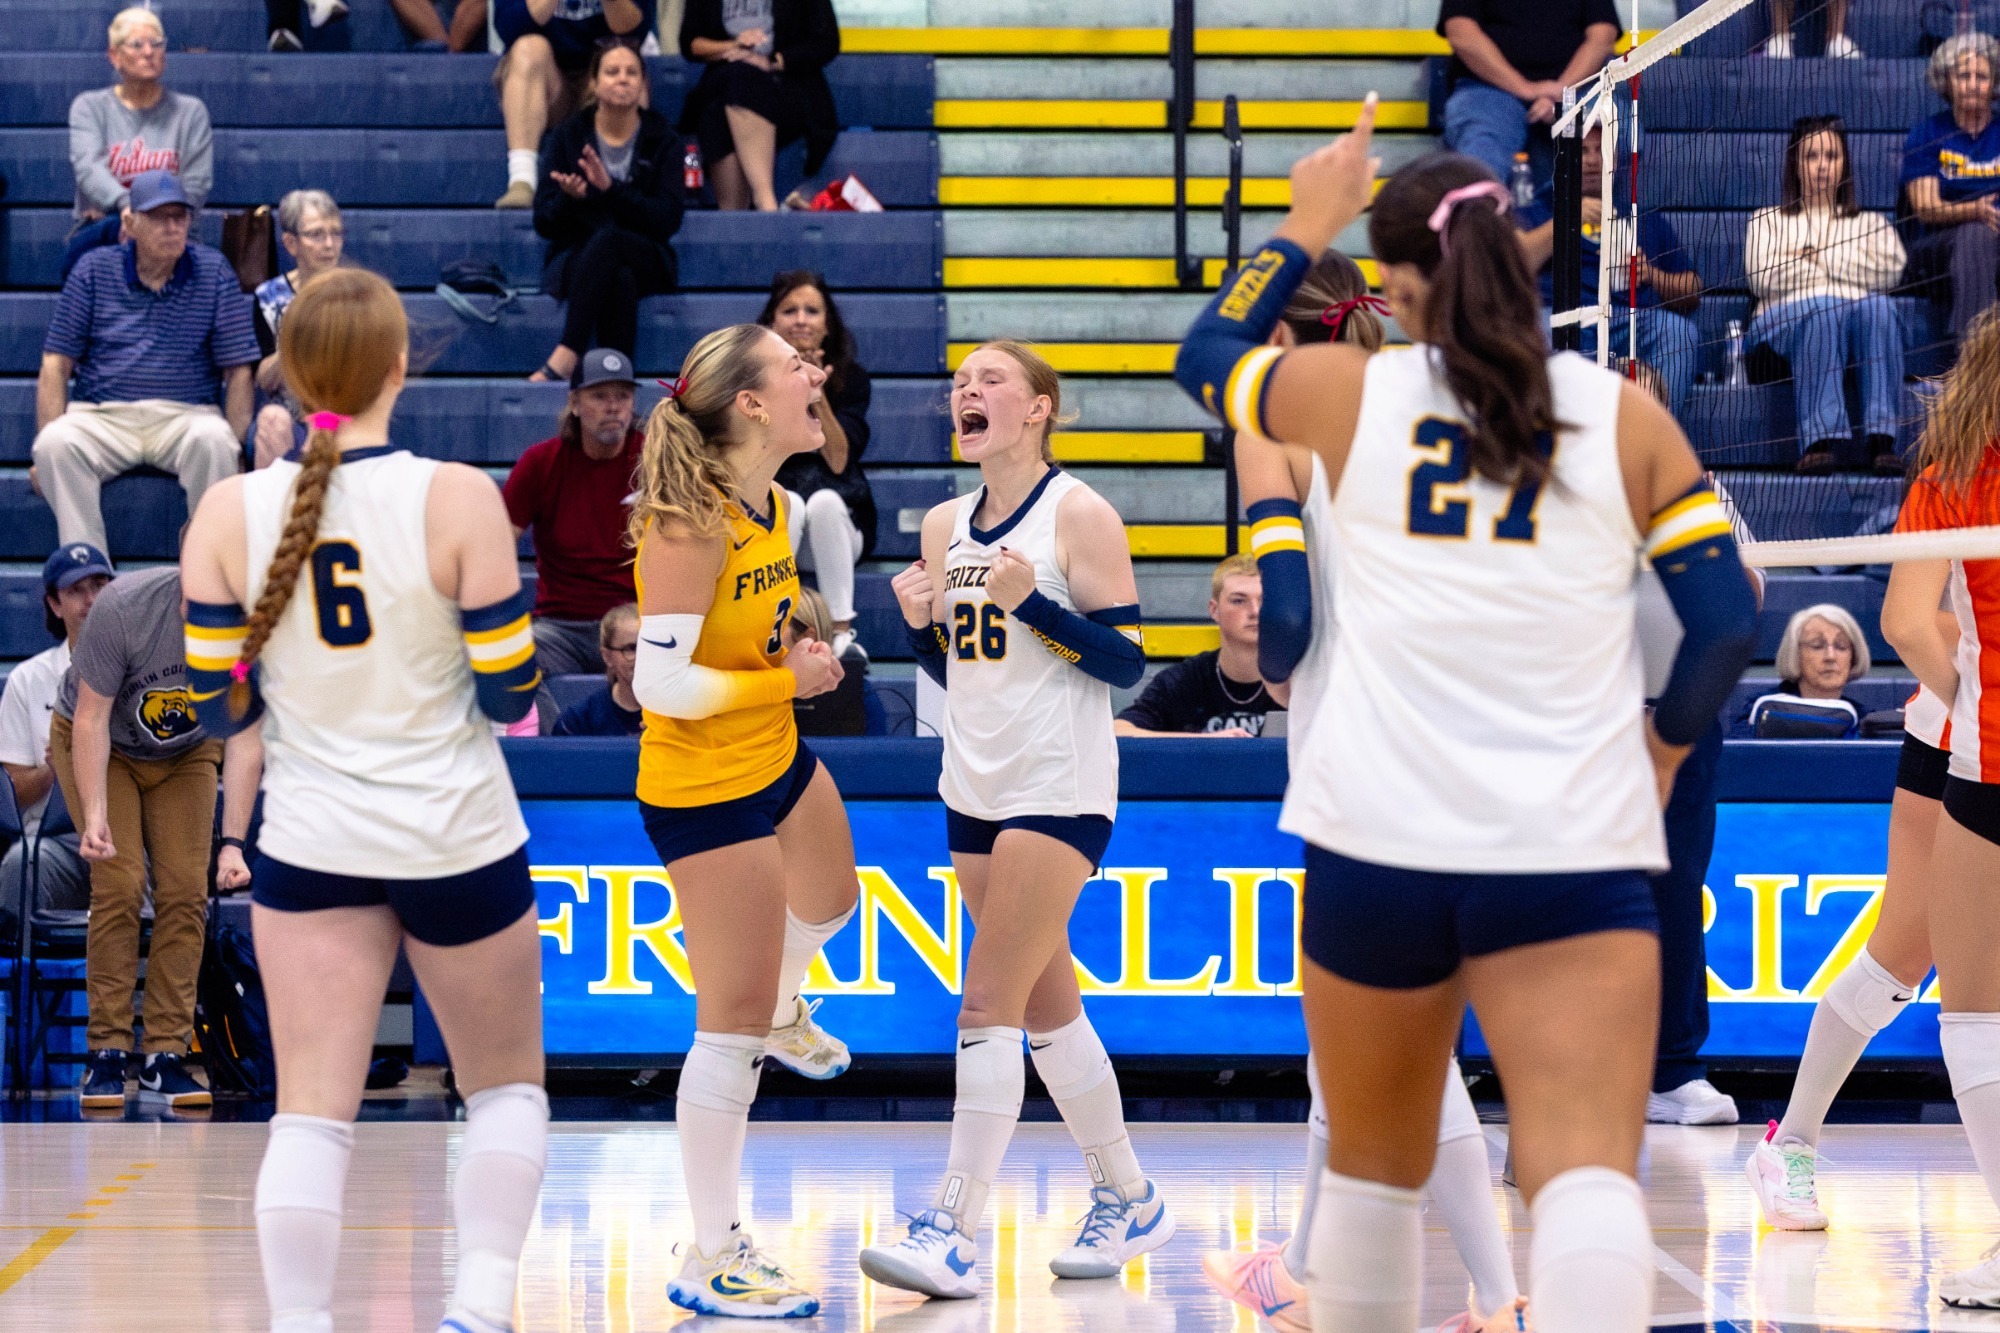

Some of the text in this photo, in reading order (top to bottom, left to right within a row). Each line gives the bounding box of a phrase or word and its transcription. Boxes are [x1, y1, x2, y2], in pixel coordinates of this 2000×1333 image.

[1406, 413, 1558, 545] 27
[309, 538, 375, 650] 6
[766, 596, 793, 657] 3
[952, 601, 1008, 663] 26
